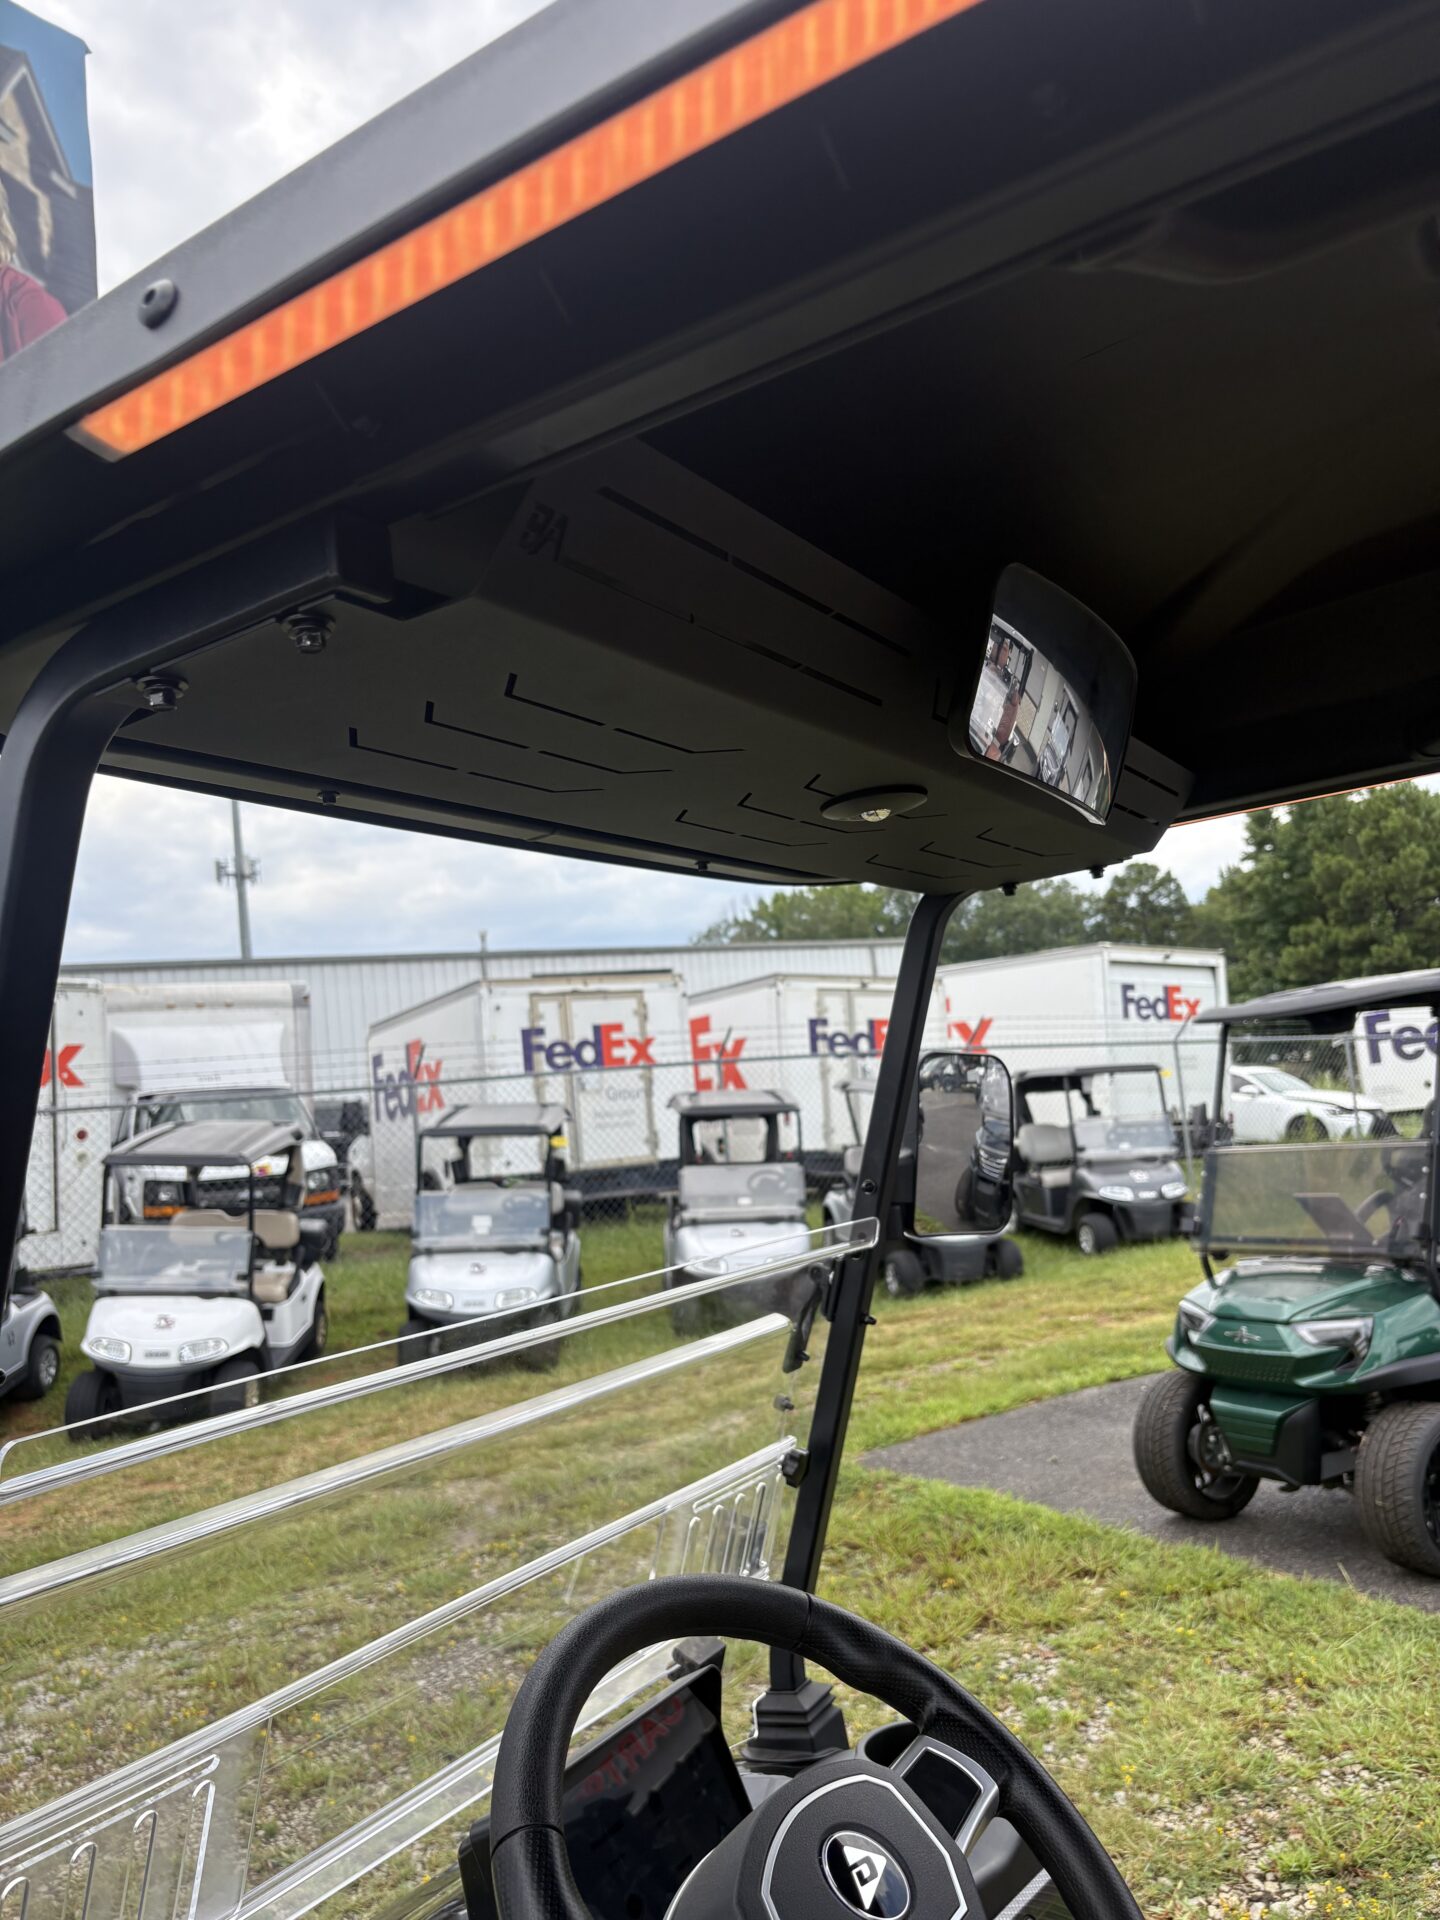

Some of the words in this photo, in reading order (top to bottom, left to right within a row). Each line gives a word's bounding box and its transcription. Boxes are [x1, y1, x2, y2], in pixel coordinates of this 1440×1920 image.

[1121, 984, 1200, 1020] FedEx
[521, 1023, 656, 1073] FedEx
[373, 1038, 445, 1121] FedEx
